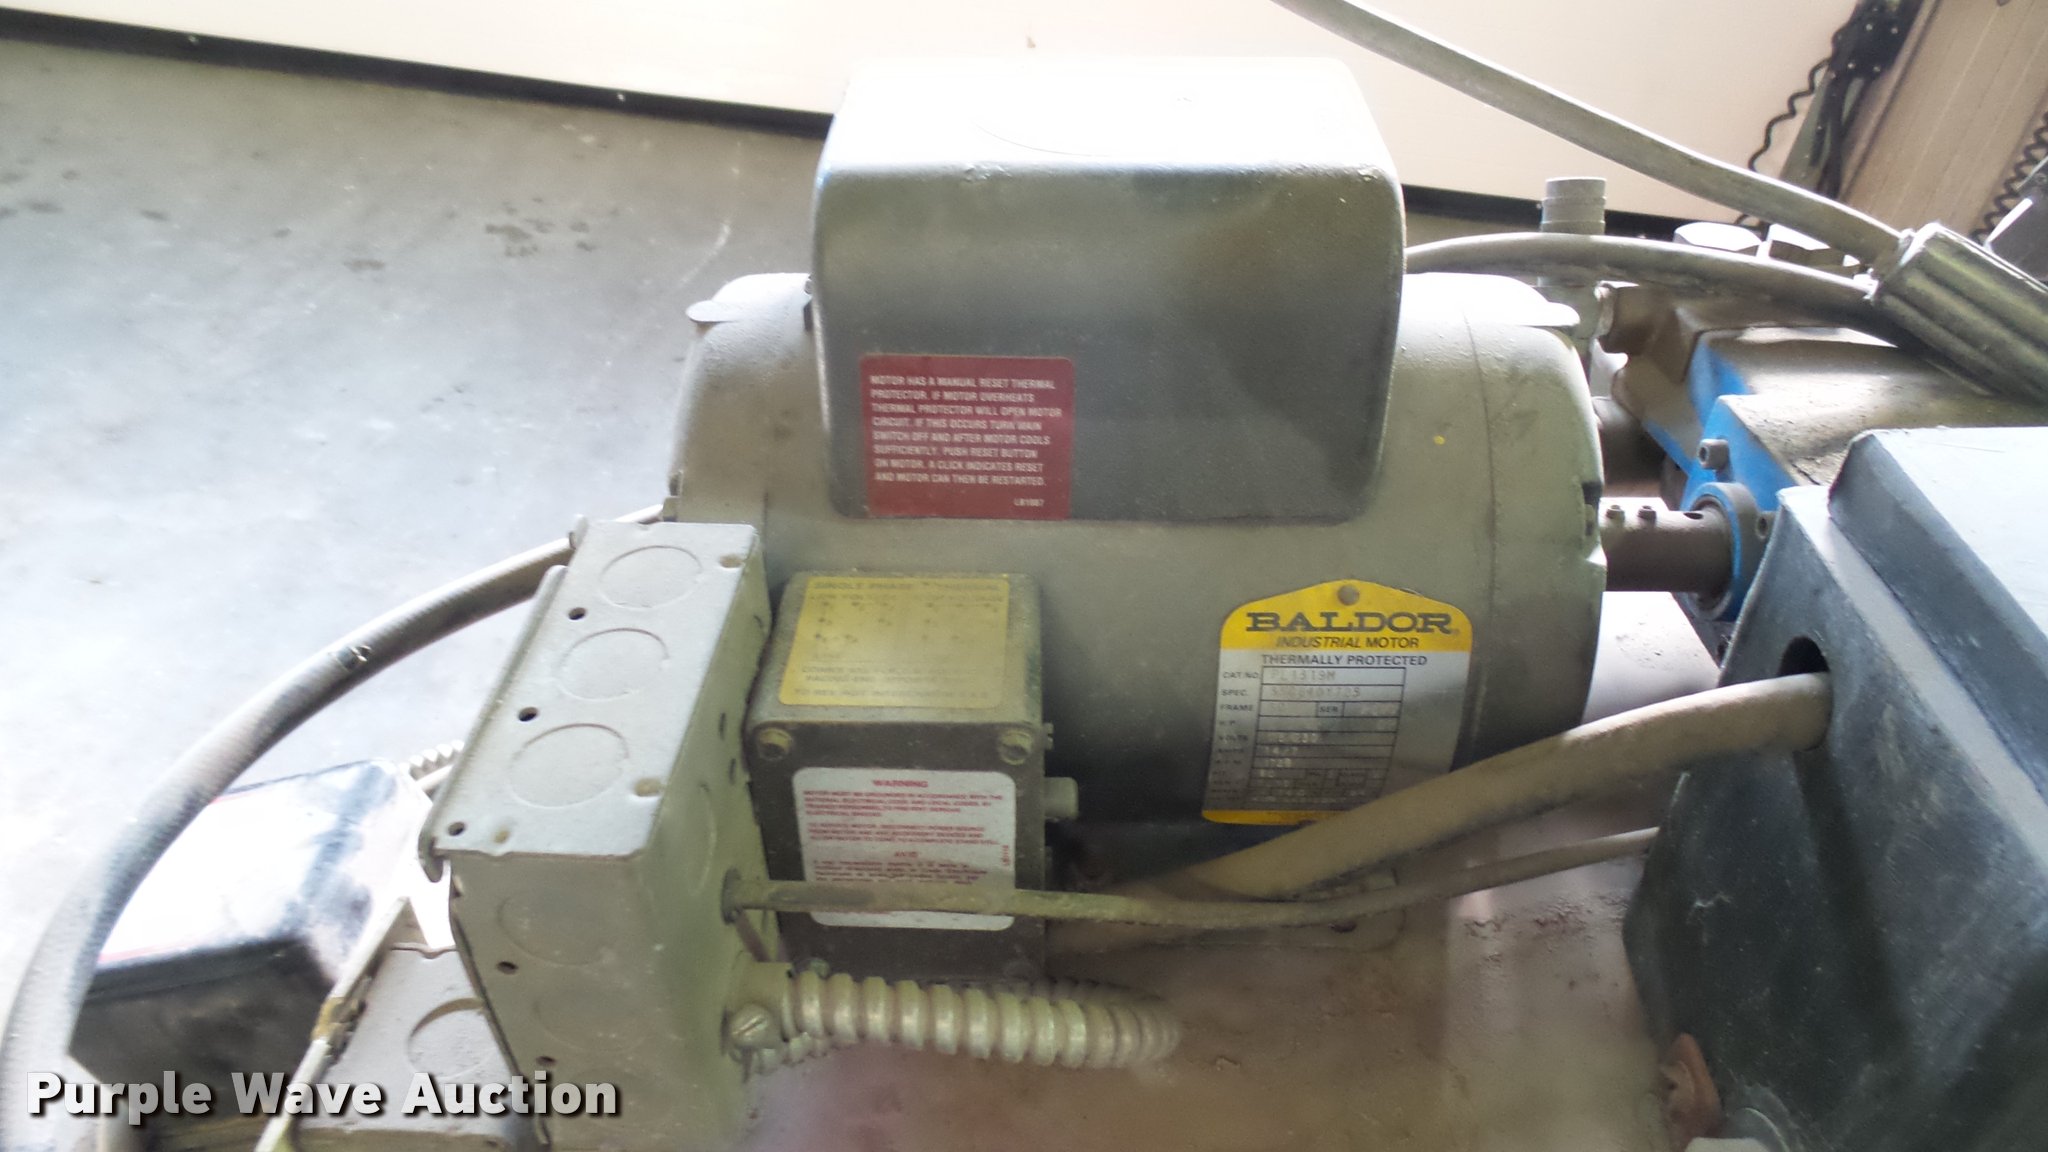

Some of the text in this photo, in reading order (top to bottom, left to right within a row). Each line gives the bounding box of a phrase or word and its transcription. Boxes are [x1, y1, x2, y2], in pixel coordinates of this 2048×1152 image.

[870, 375, 1055, 389] MOTOR HAS A MANUAL RESET THERMAL
[932, 391, 941, 400] IF
[943, 391, 977, 401] MOTOR
[979, 392, 1035, 402] OVERHEATS
[872, 403, 1062, 417] THERMAL PROTECTOR WILL OPEN MOTOR
[915, 418, 924, 427] IF
[926, 418, 947, 428] THIS
[950, 419, 988, 429] OCCURS
[990, 420, 1015, 430] TURN
[872, 431, 1051, 445] SWITCH OFF AND AFTER MOTOR COOLS
[943, 447, 968, 457] PUSH
[970, 448, 999, 457] RESET
[1001, 448, 1038, 458] BUTTON
[874, 458, 889, 468] ON
[928, 460, 936, 469] A
[937, 461, 963, 470] CLICK
[965, 461, 1013, 471] INDICATES
[1015, 462, 1044, 472] RESET
[874, 472, 1047, 486] AND MOTOR CAN THEN BE RESTARTED.
[1246, 612, 1453, 635] BALDOR
[1276, 636, 1419, 649] INDUSTRIAL MOTOR
[1262, 655, 1428, 666] THERMALLY PROTECTED
[872, 780, 928, 788] WARNING
